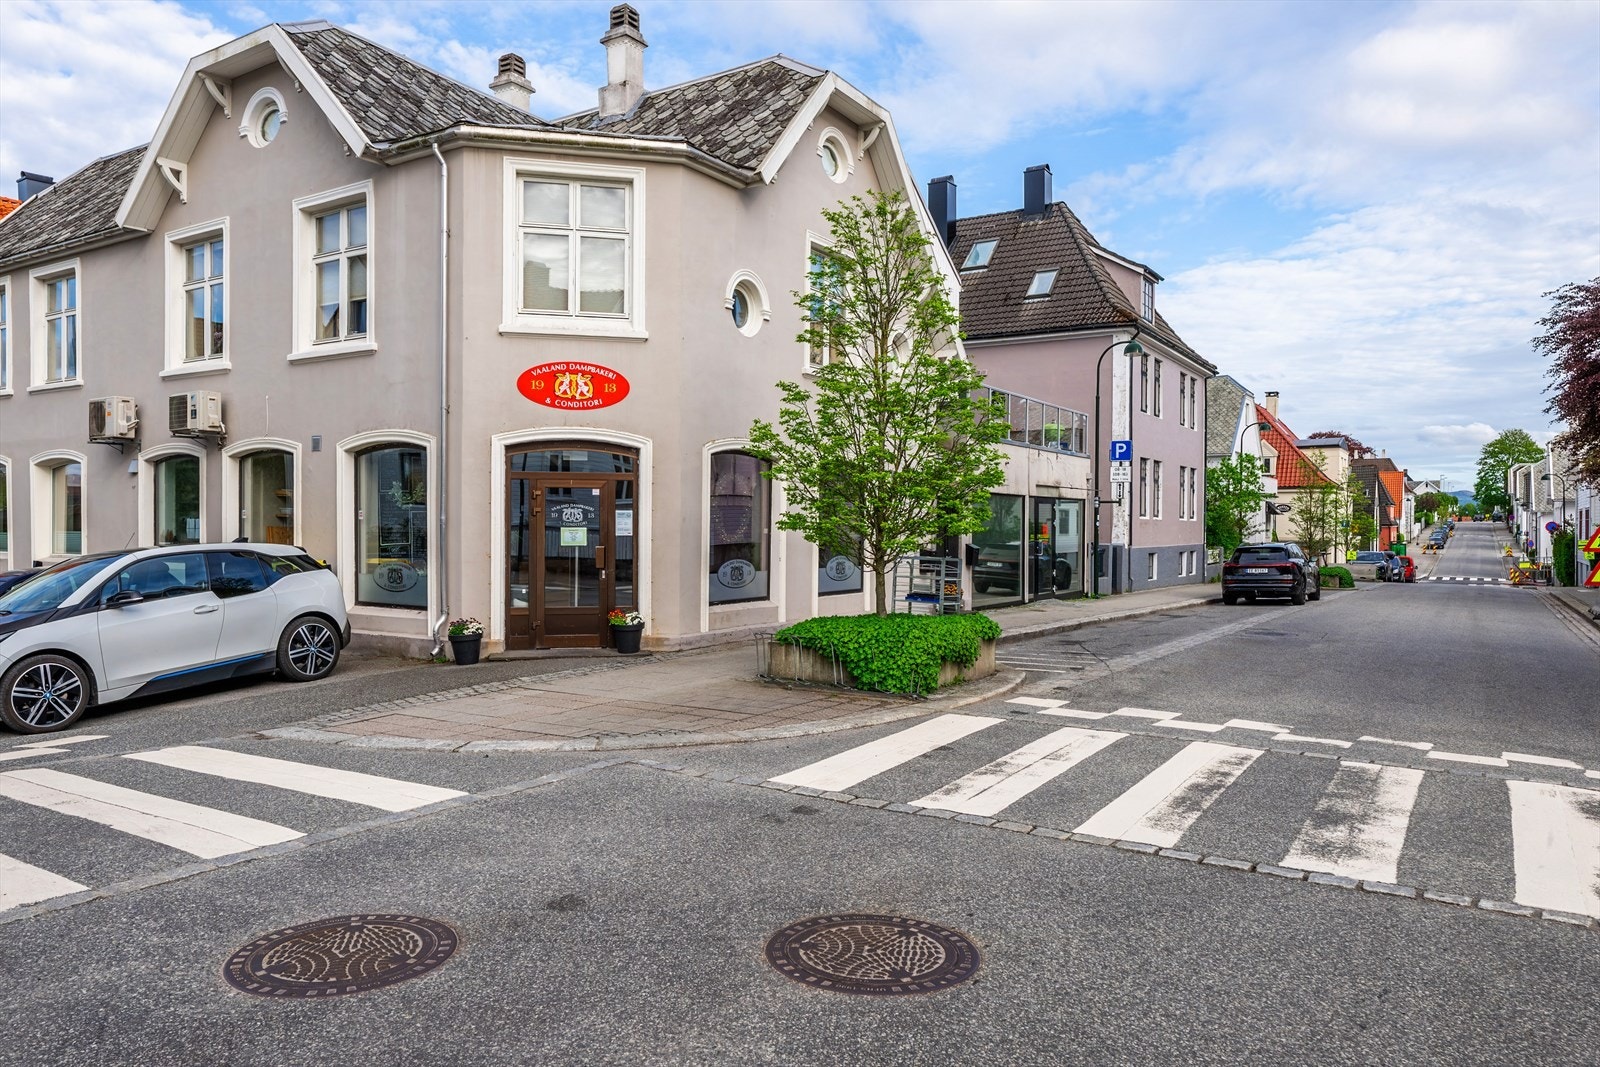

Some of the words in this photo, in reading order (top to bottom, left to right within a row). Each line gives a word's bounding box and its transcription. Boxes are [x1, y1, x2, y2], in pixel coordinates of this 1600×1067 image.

[531, 363, 567, 376] VAALAND
[569, 363, 617, 380] DAMPBAKERI
[530, 380, 545, 390] 19
[603, 383, 617, 393] 13
[555, 398, 603, 408] CONDITORI
[1115, 443, 1127, 459] P
